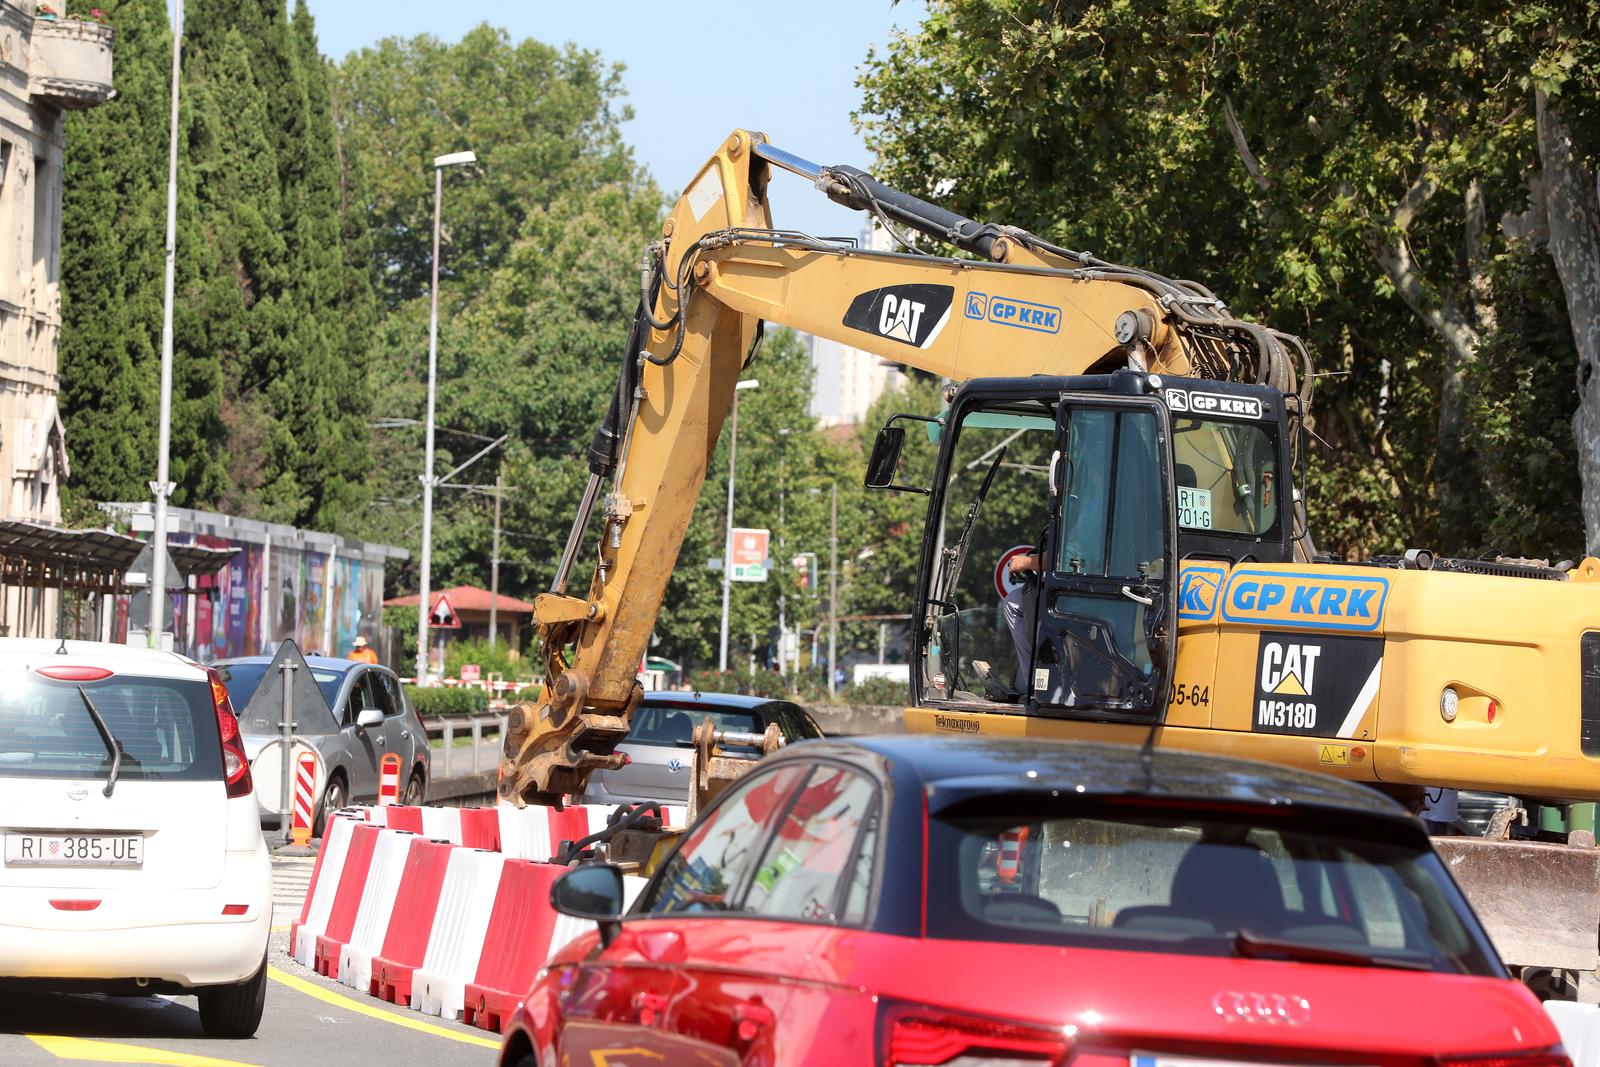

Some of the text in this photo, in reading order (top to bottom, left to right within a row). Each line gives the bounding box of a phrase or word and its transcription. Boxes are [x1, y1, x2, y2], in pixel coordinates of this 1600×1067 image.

[879, 294, 926, 343] CAT
[993, 303, 1016, 320] GP
[1019, 308, 1057, 328] KRK
[1193, 396, 1217, 410] GP
[1220, 399, 1258, 415] KRK
[1180, 490, 1194, 507] RI
[1232, 581, 1285, 612] GP
[1290, 585, 1377, 618] KRK
[1261, 642, 1321, 696] CAT
[1258, 700, 1317, 729] M318D
[21, 836, 138, 859] RI 385-UE
